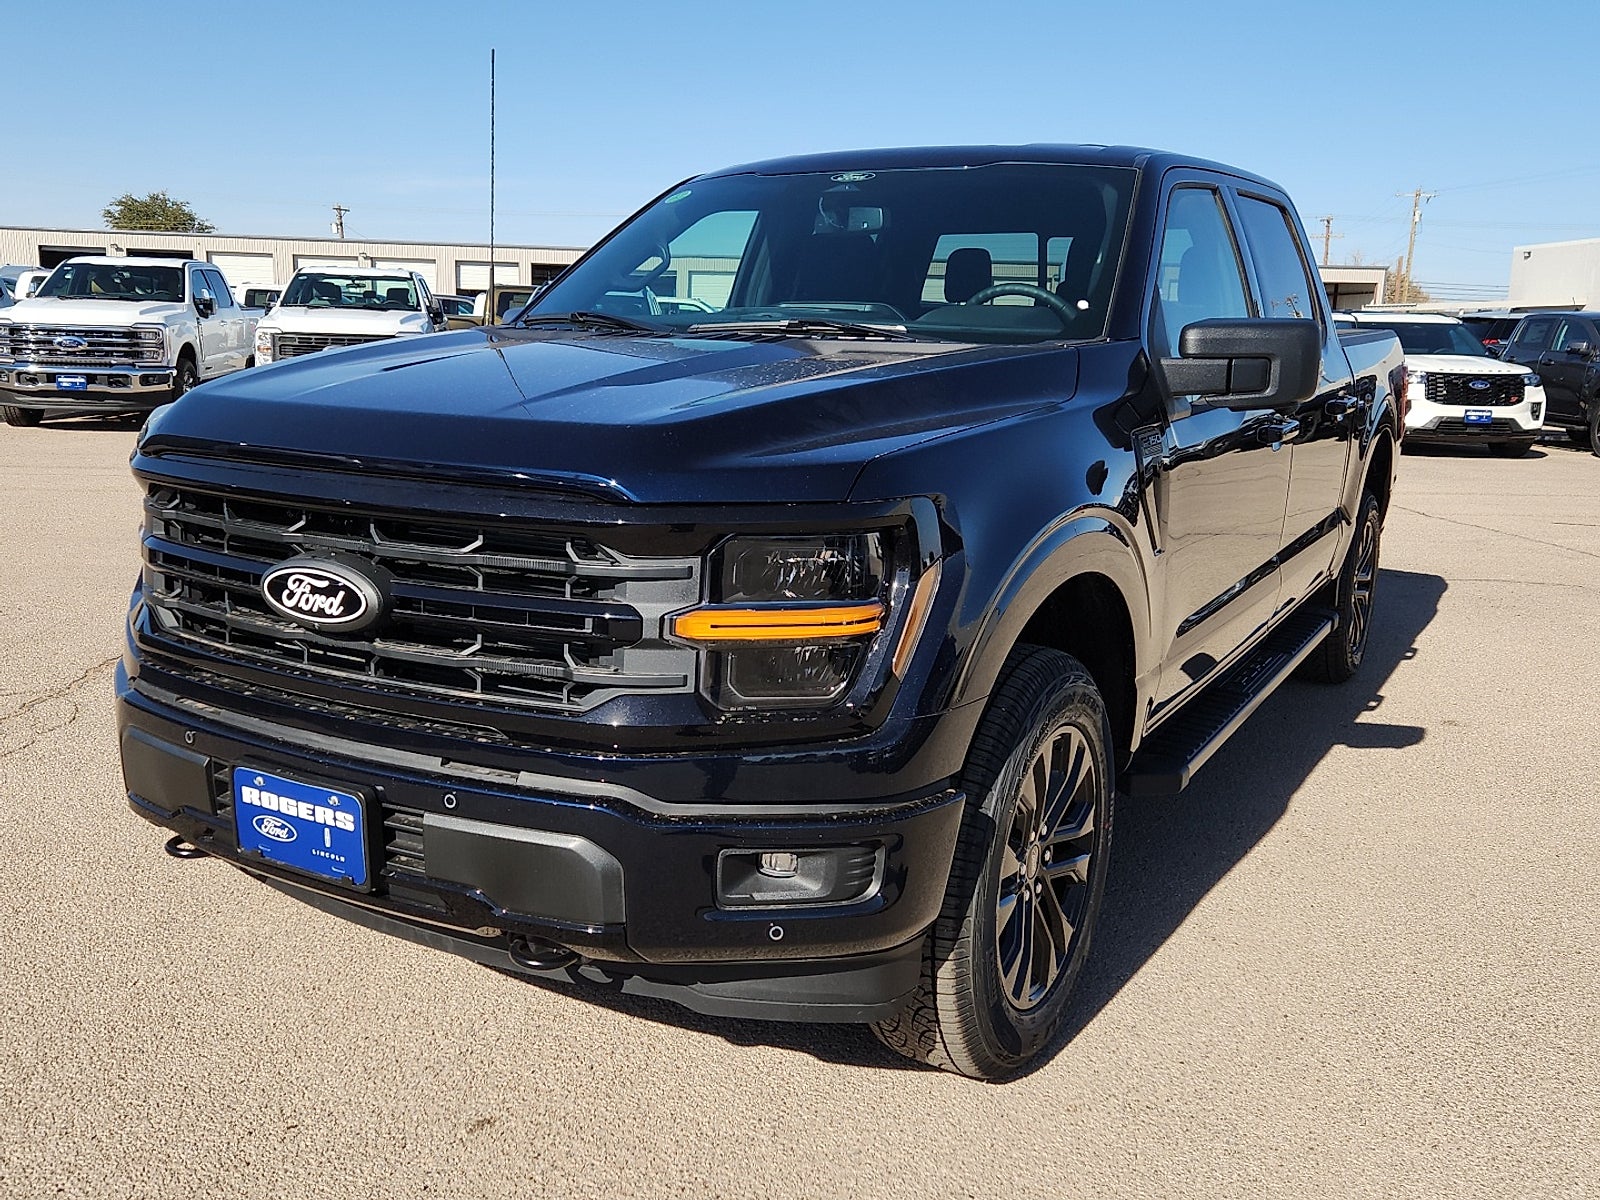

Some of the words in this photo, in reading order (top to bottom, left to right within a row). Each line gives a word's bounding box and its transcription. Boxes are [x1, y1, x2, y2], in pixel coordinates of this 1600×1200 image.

[281, 574, 345, 615] Ford
[241, 786, 355, 831] ROGERS
[260, 816, 289, 838] Ford
[311, 848, 346, 863] LINCOLN
